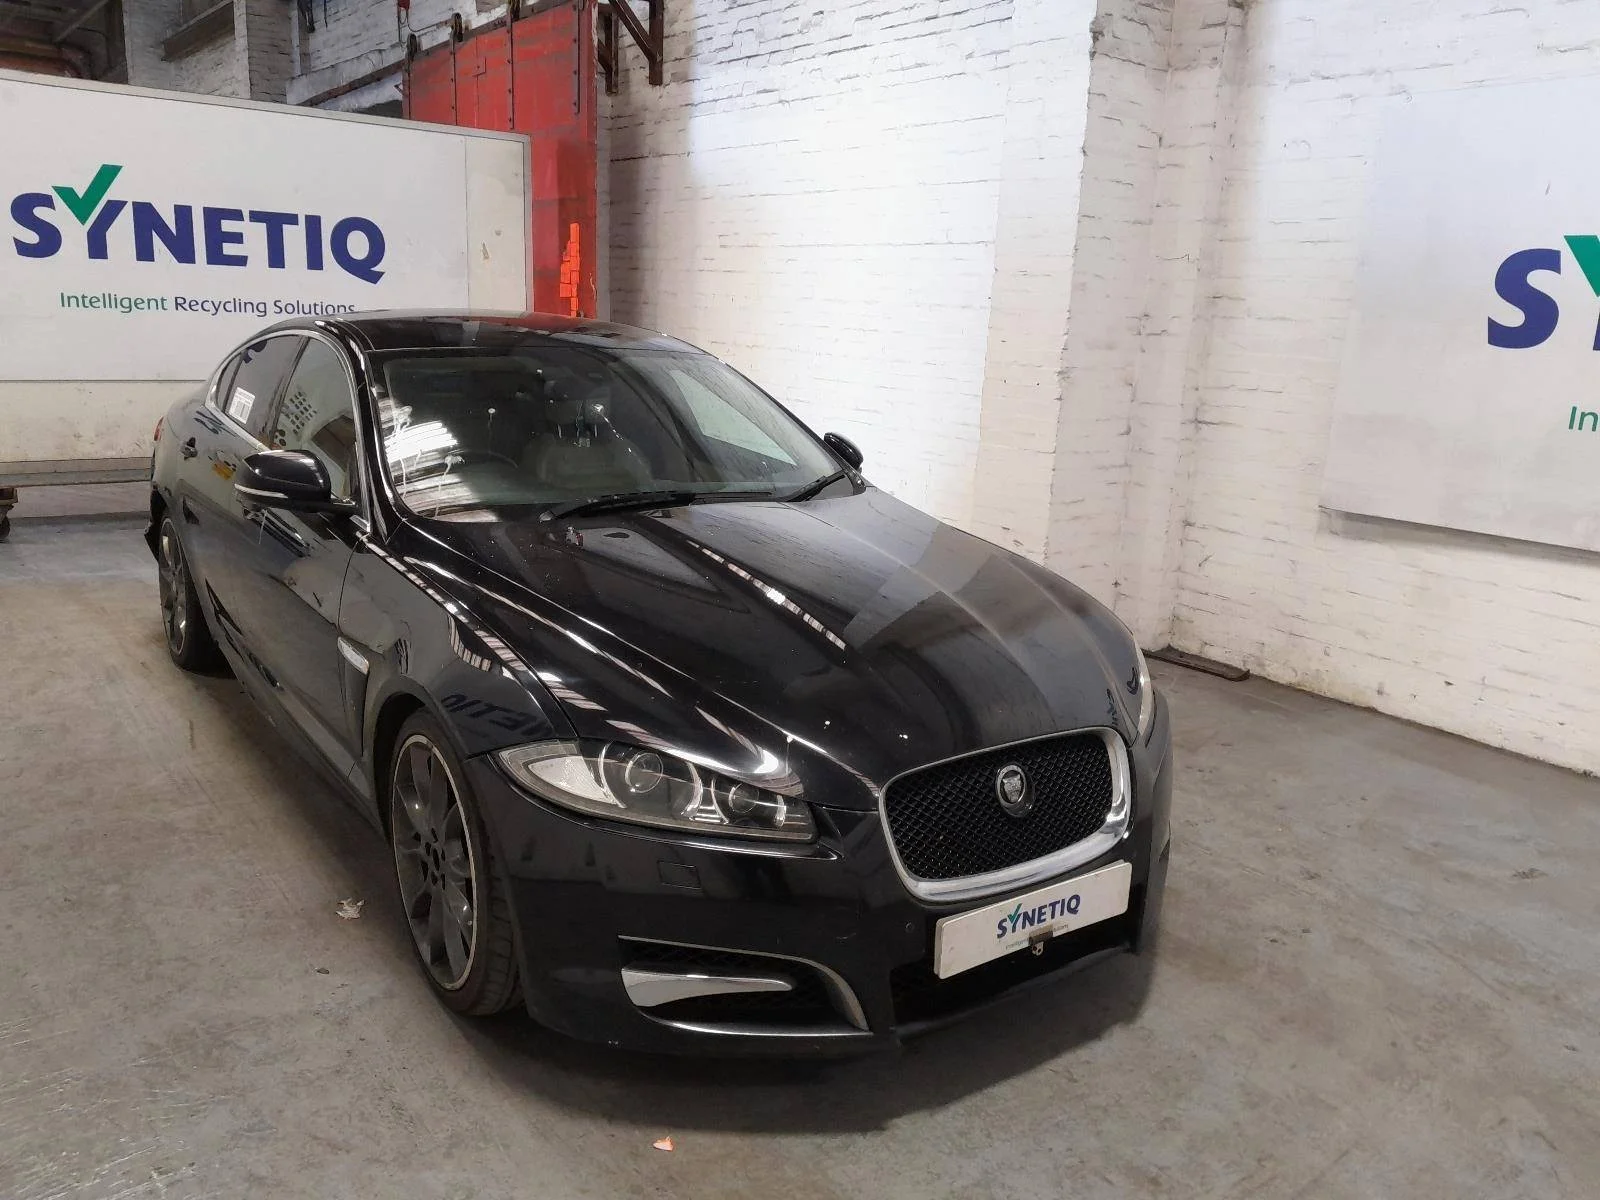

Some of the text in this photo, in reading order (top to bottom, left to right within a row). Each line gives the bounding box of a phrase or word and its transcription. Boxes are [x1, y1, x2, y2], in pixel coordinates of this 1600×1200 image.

[10, 164, 386, 284] SYNETIQ
[60, 291, 356, 317] Intelligent Recycling Solutions
[997, 894, 1081, 939] SYNETIQ
